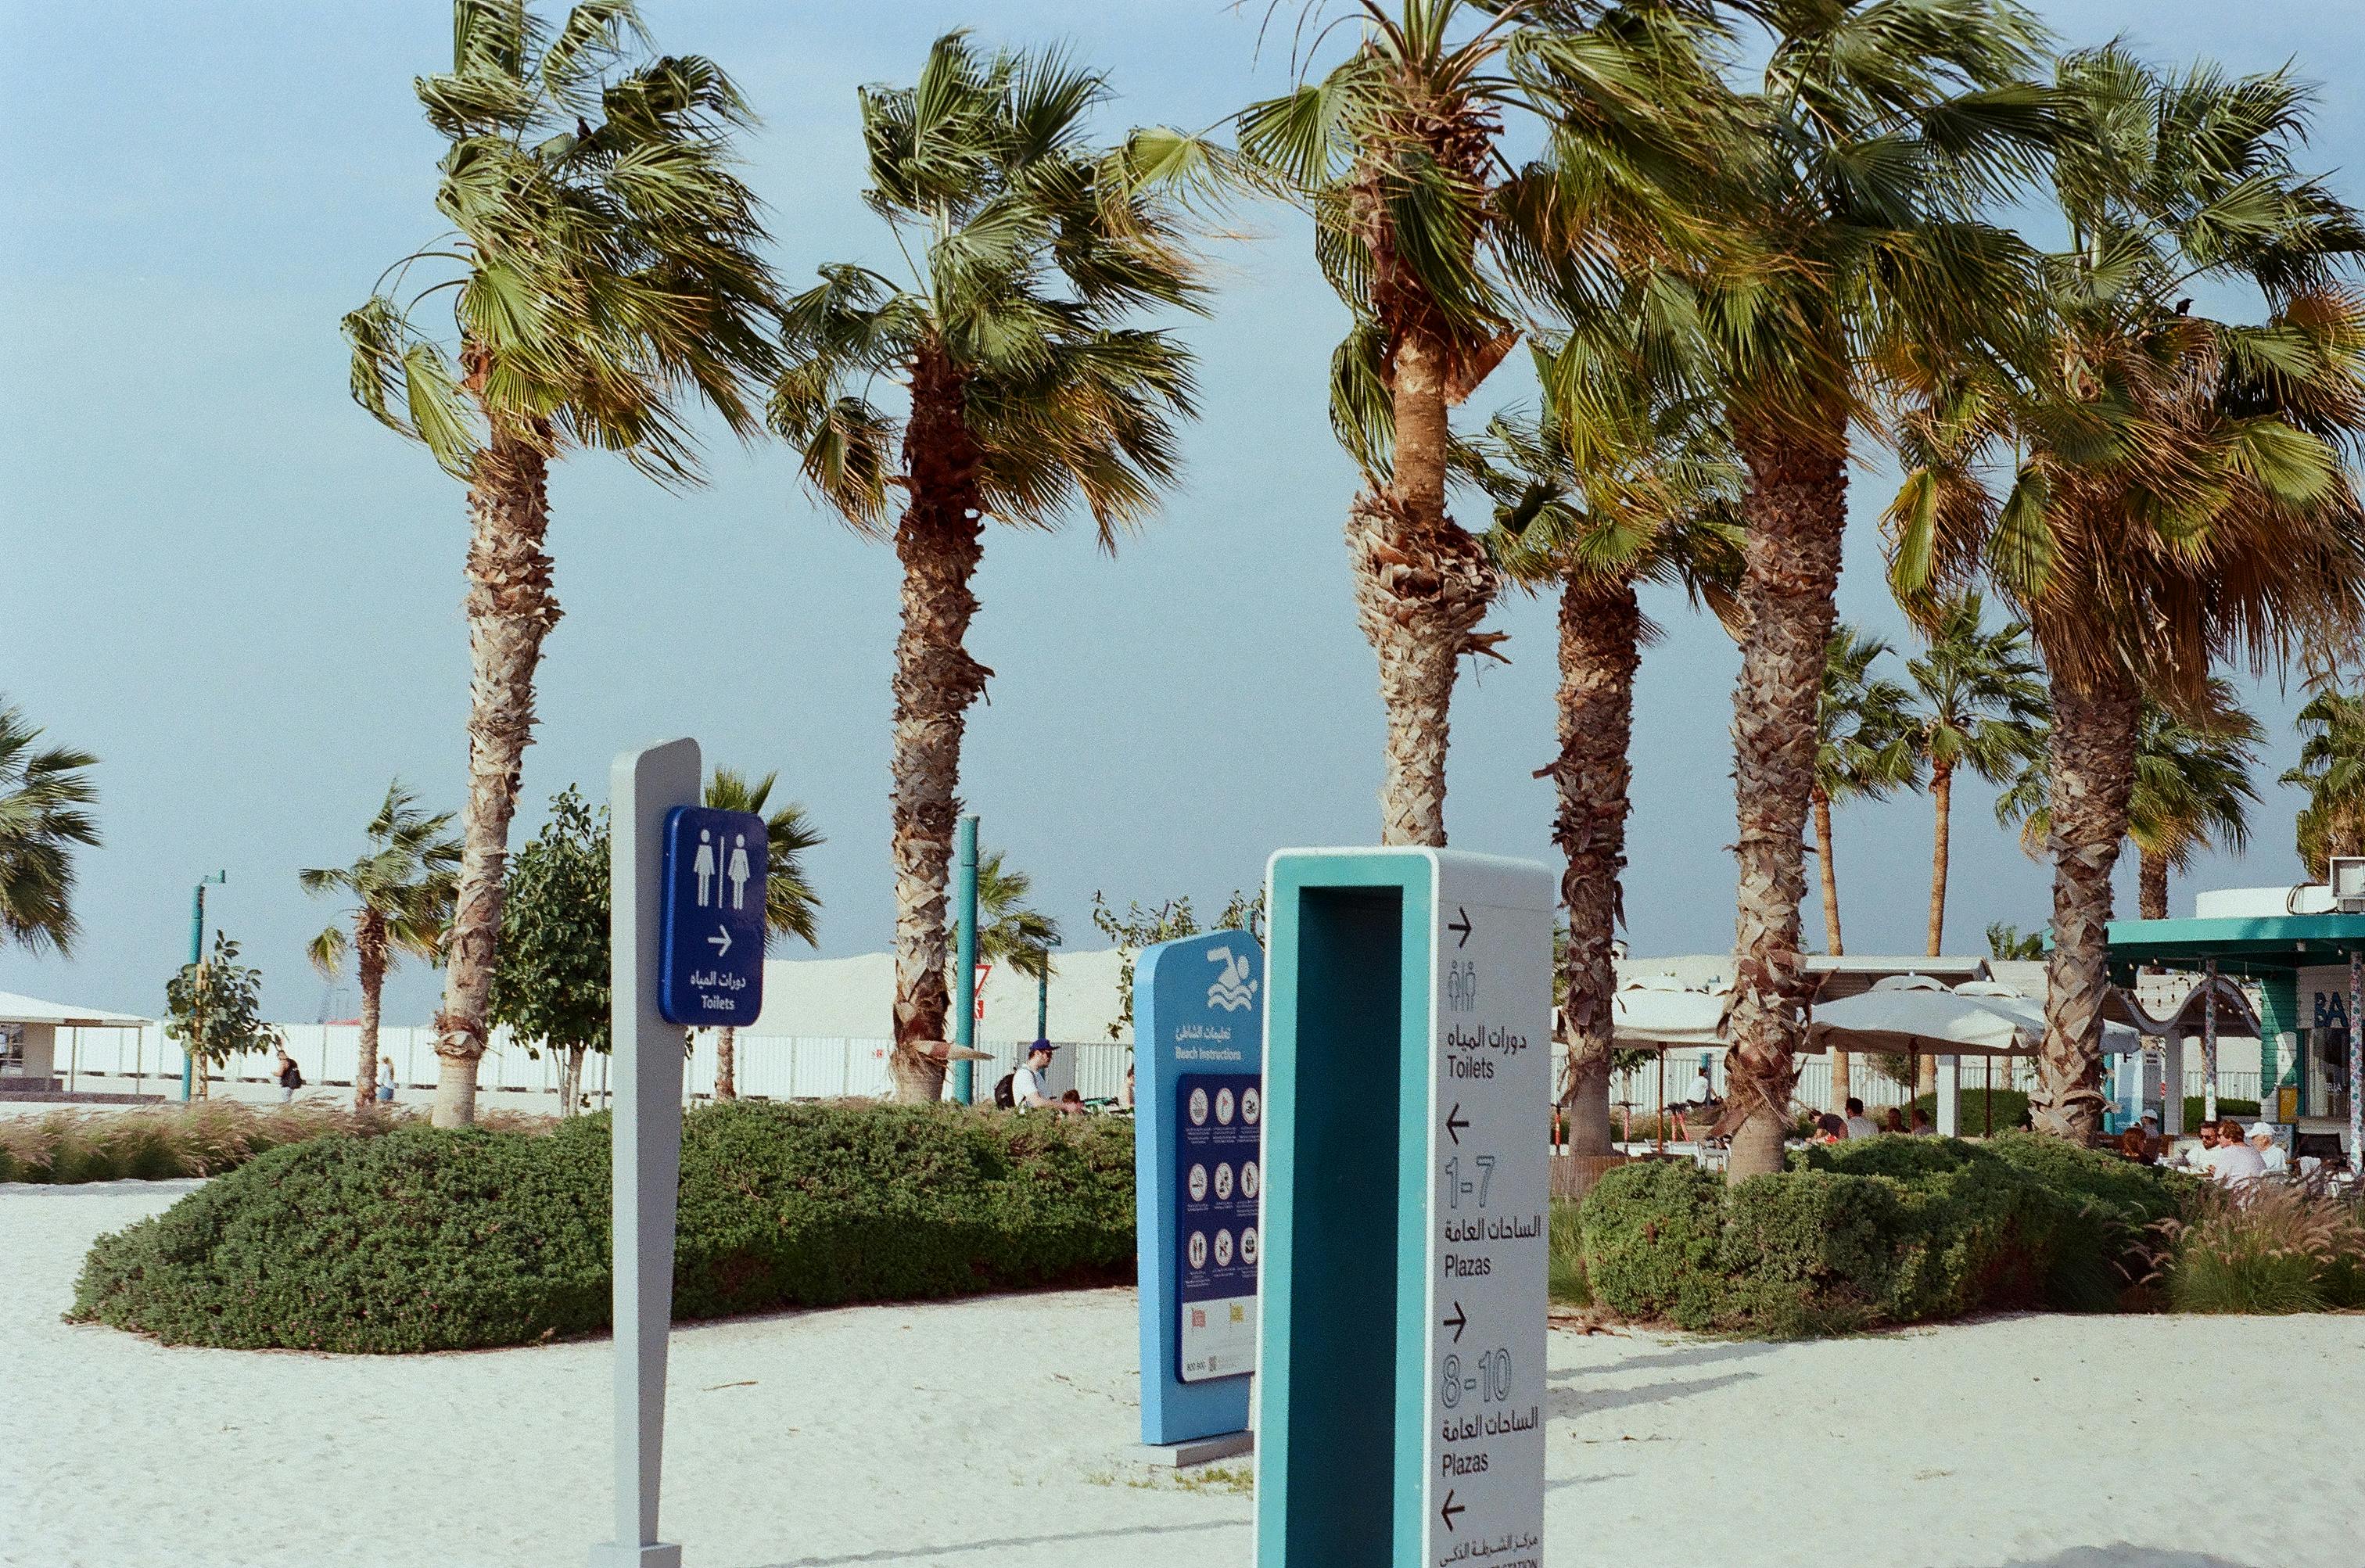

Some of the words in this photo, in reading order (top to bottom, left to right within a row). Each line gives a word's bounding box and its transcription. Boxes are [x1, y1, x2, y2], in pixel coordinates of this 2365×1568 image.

[690, 970, 717, 989] المياه
[718, 972, 747, 991] دورات
[701, 994, 735, 1010] Toilets
[1448, 1024, 1486, 1052] المياه
[1488, 1026, 1527, 1056] دورات
[1175, 1046, 1198, 1059] Beach
[1199, 1048, 1241, 1060] Instructions
[1448, 1055, 1495, 1079] Toilets
[1445, 1155, 1495, 1210] 1-7
[1445, 1217, 1485, 1243] العامة
[1488, 1215, 1541, 1240] الساحات
[1445, 1254, 1491, 1277] Plazas
[1441, 1347, 1512, 1408] 8-10
[1442, 1413, 1483, 1441] العامة
[1486, 1406, 1538, 1435] الساحات
[1442, 1452, 1488, 1477] Plazas
[1513, 1532, 1538, 1552] مركز
